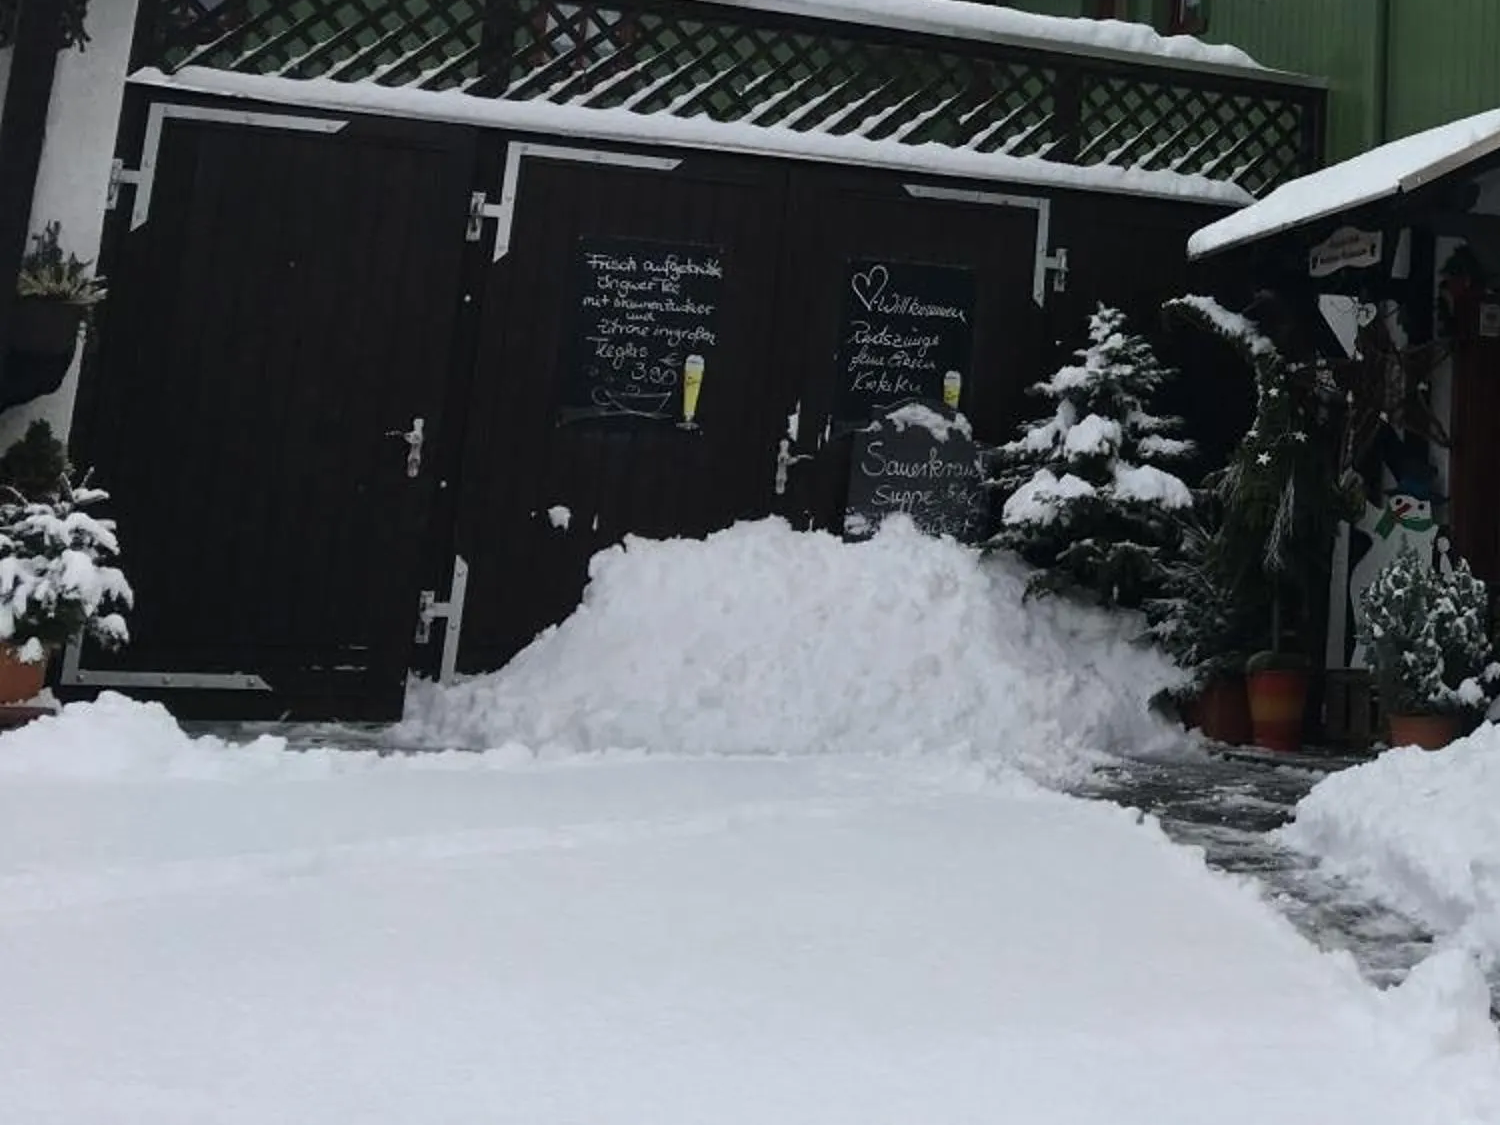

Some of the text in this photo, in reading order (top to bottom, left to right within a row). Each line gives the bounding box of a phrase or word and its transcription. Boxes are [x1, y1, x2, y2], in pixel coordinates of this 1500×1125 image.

[585, 252, 637, 272] Frisch
[583, 295, 609, 307] mit
[861, 441, 987, 480] Sauerkraut
[871, 485, 940, 513] Suppe
